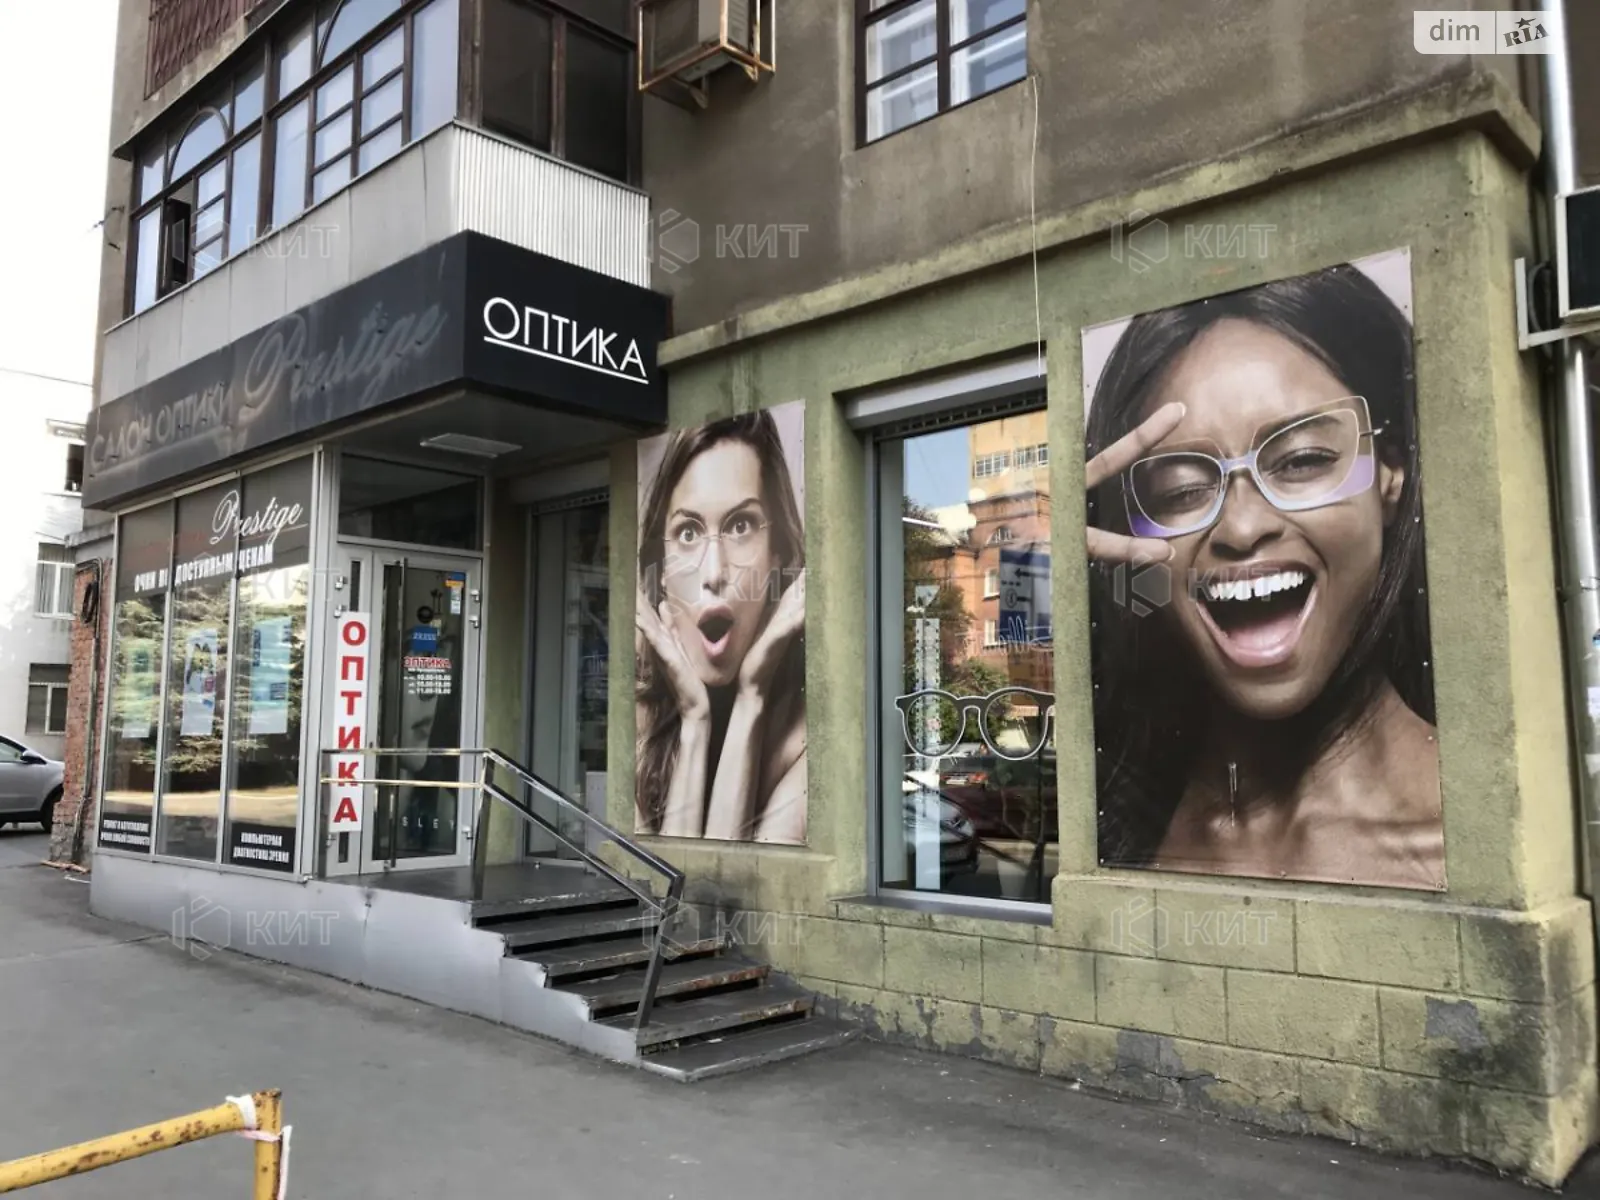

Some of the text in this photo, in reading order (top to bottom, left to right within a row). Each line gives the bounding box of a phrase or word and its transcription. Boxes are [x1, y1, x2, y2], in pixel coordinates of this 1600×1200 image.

[483, 296, 647, 377] ОПТИКА
[209, 489, 304, 545] Prestige
[238, 545, 273, 573] ЦЕНАМ
[333, 620, 367, 824] ОПТИКА
